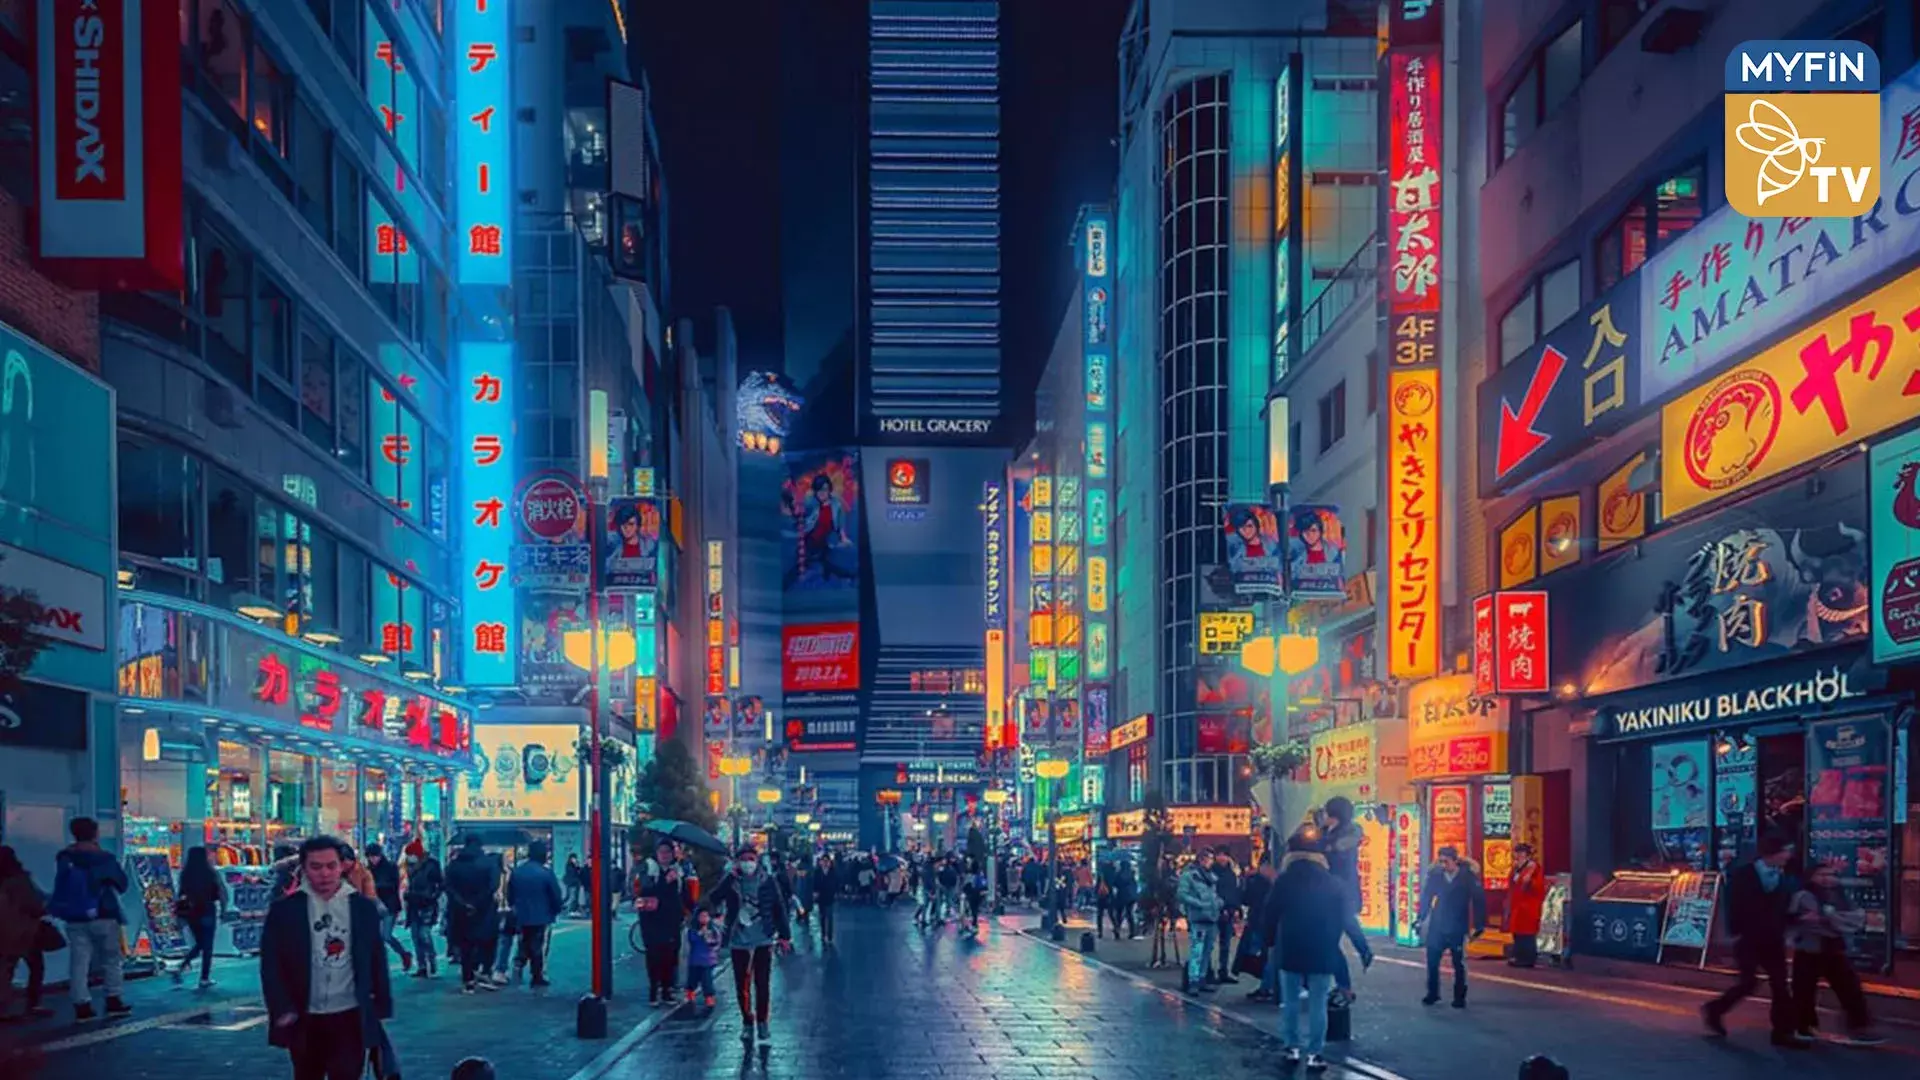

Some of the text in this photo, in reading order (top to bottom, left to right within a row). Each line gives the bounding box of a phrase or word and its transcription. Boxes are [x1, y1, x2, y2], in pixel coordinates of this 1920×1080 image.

[74, 16, 106, 183] SHIDAX
[1405, 57, 1425, 163] 手作り居酒屋
[1391, 166, 1440, 296] 甘太郎
[1659, 104, 1920, 311] 手作り屋
[1396, 316, 1435, 339] 4F
[1396, 341, 1434, 364] 3F
[1582, 303, 1629, 426] 入口
[1790, 310, 1920, 437] や
[880, 419, 991, 433] HOTEL GRACERY
[472, 373, 506, 653] カラオケ館
[527, 498, 574, 523] 消火栓
[1398, 422, 1430, 668] やきとりセンター
[1508, 624, 1536, 681] 焼肉
[1713, 529, 1770, 653] 焼肉
[1616, 666, 1866, 733] YAKINIKU BLACKHOL
